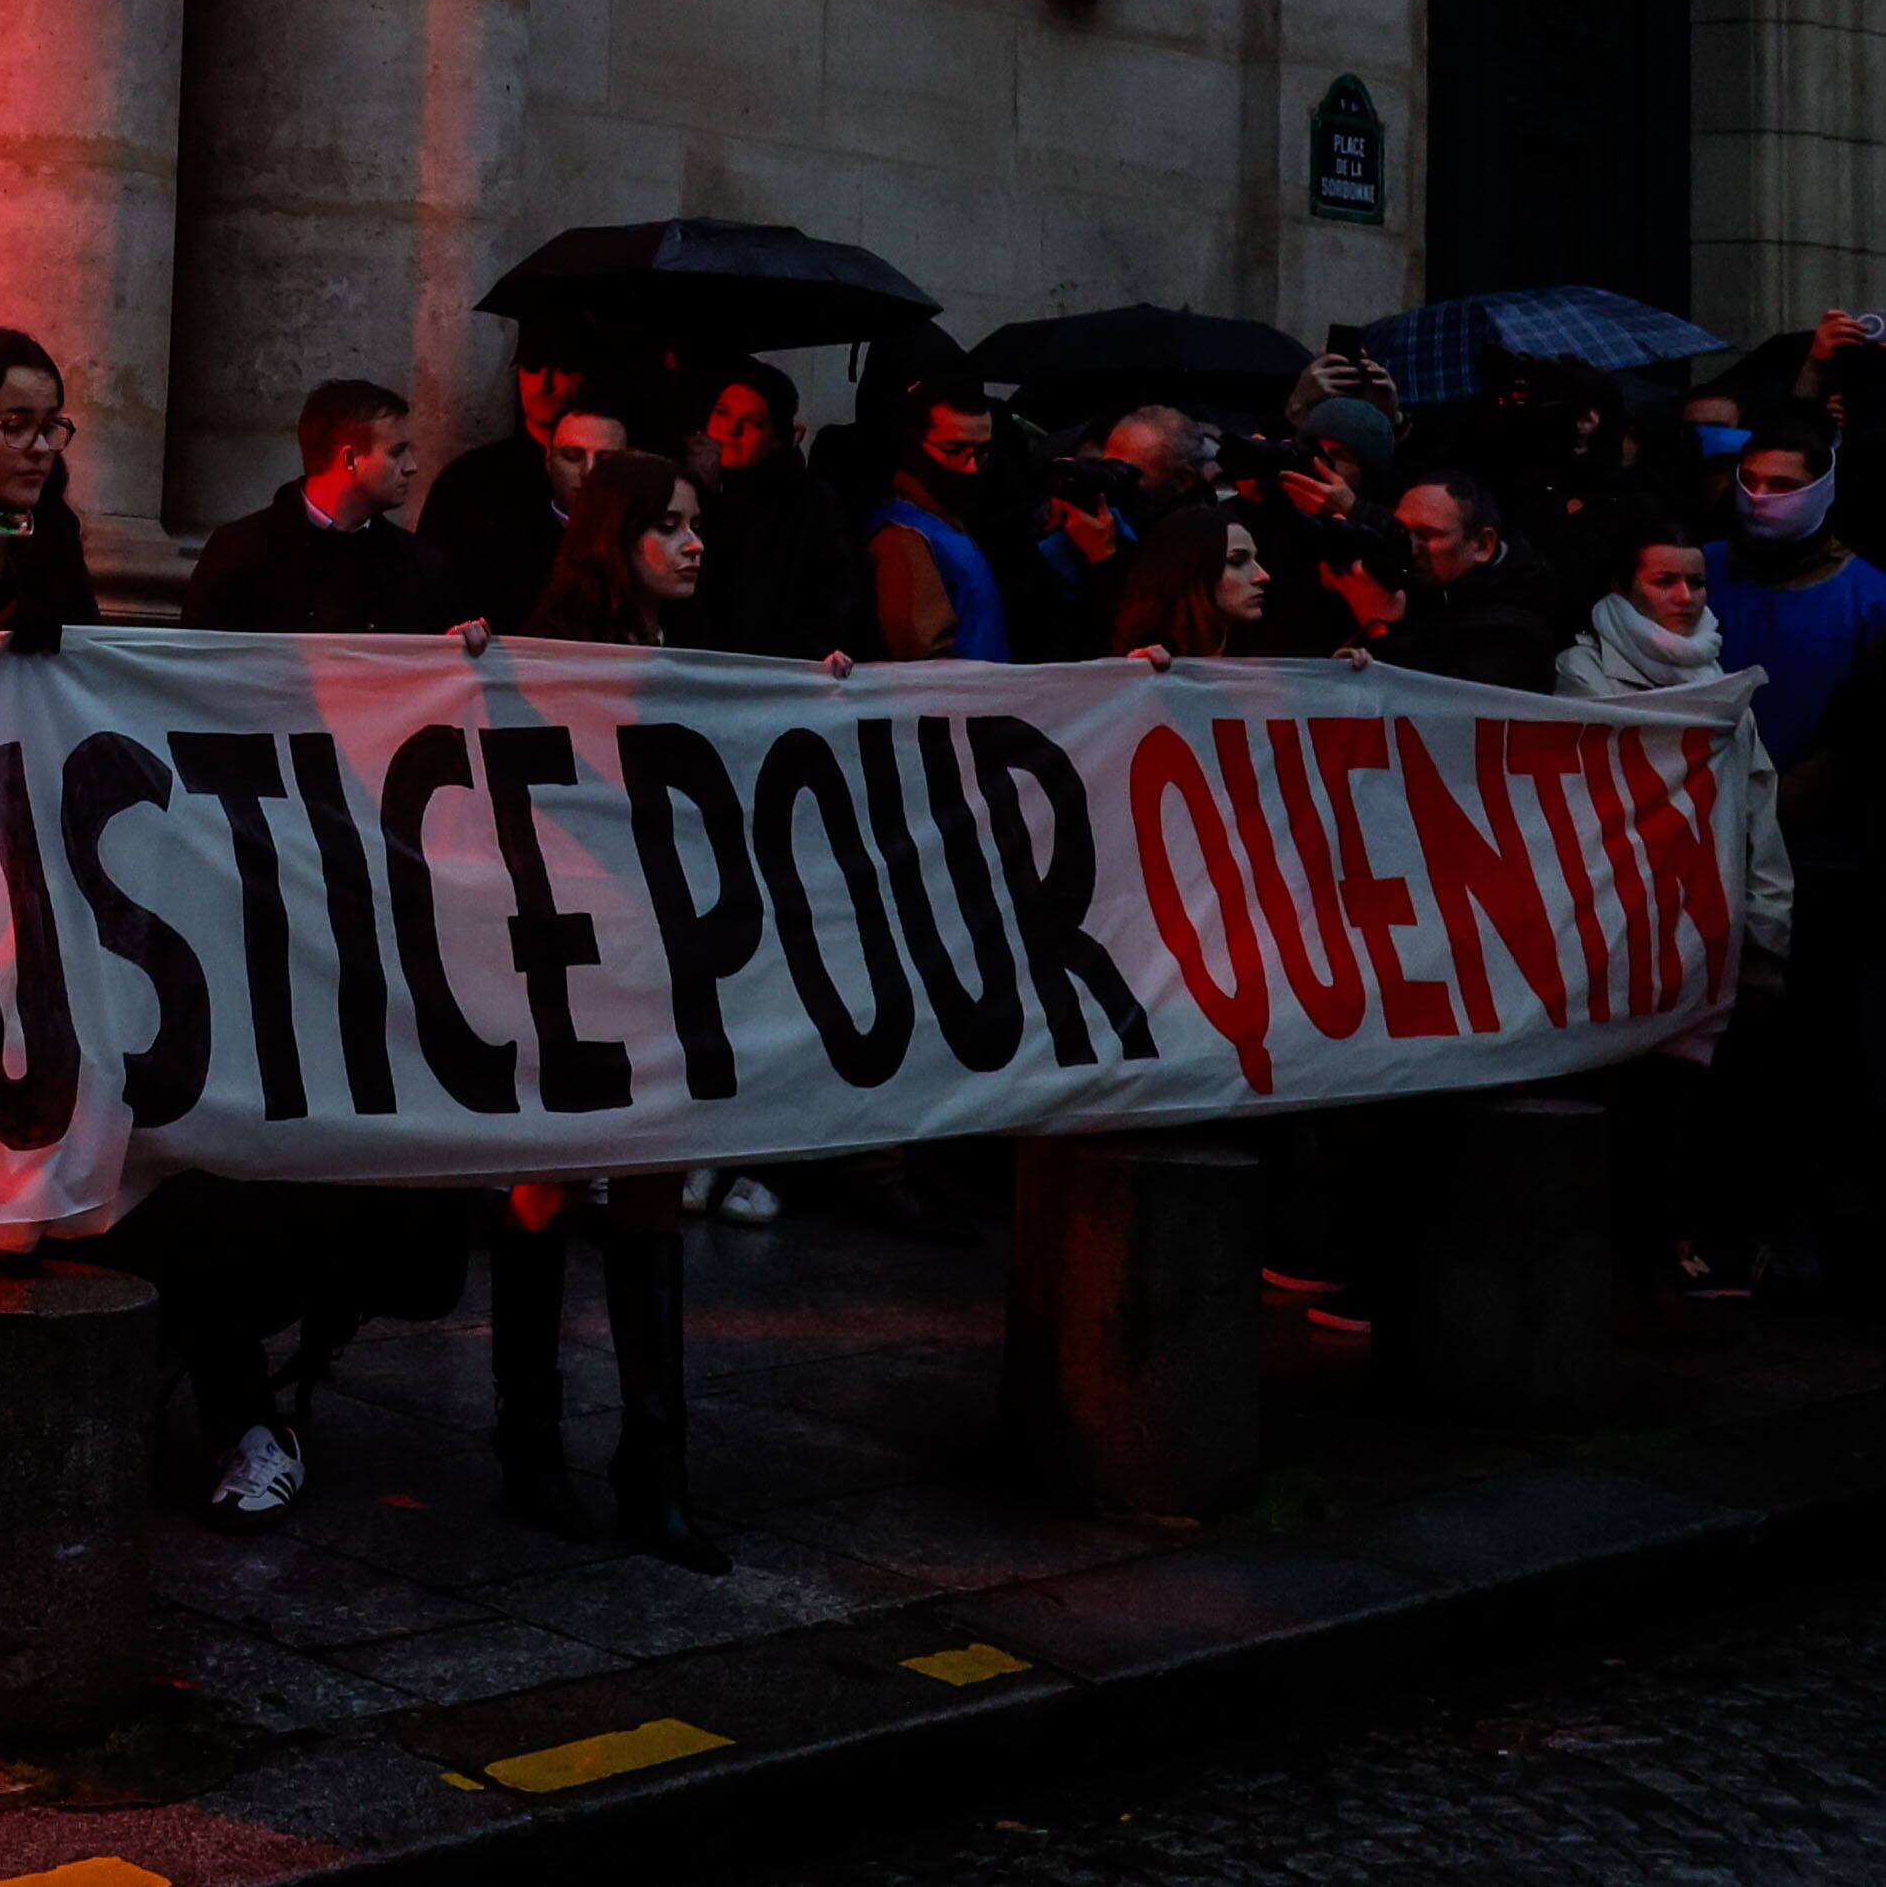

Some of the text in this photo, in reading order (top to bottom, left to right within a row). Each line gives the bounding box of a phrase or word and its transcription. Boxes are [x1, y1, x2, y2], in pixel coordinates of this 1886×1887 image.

[1333, 132, 1366, 158] PLACE
[617, 715, 1160, 1100] POUR
[1130, 717, 1733, 1096] QUENTIN
